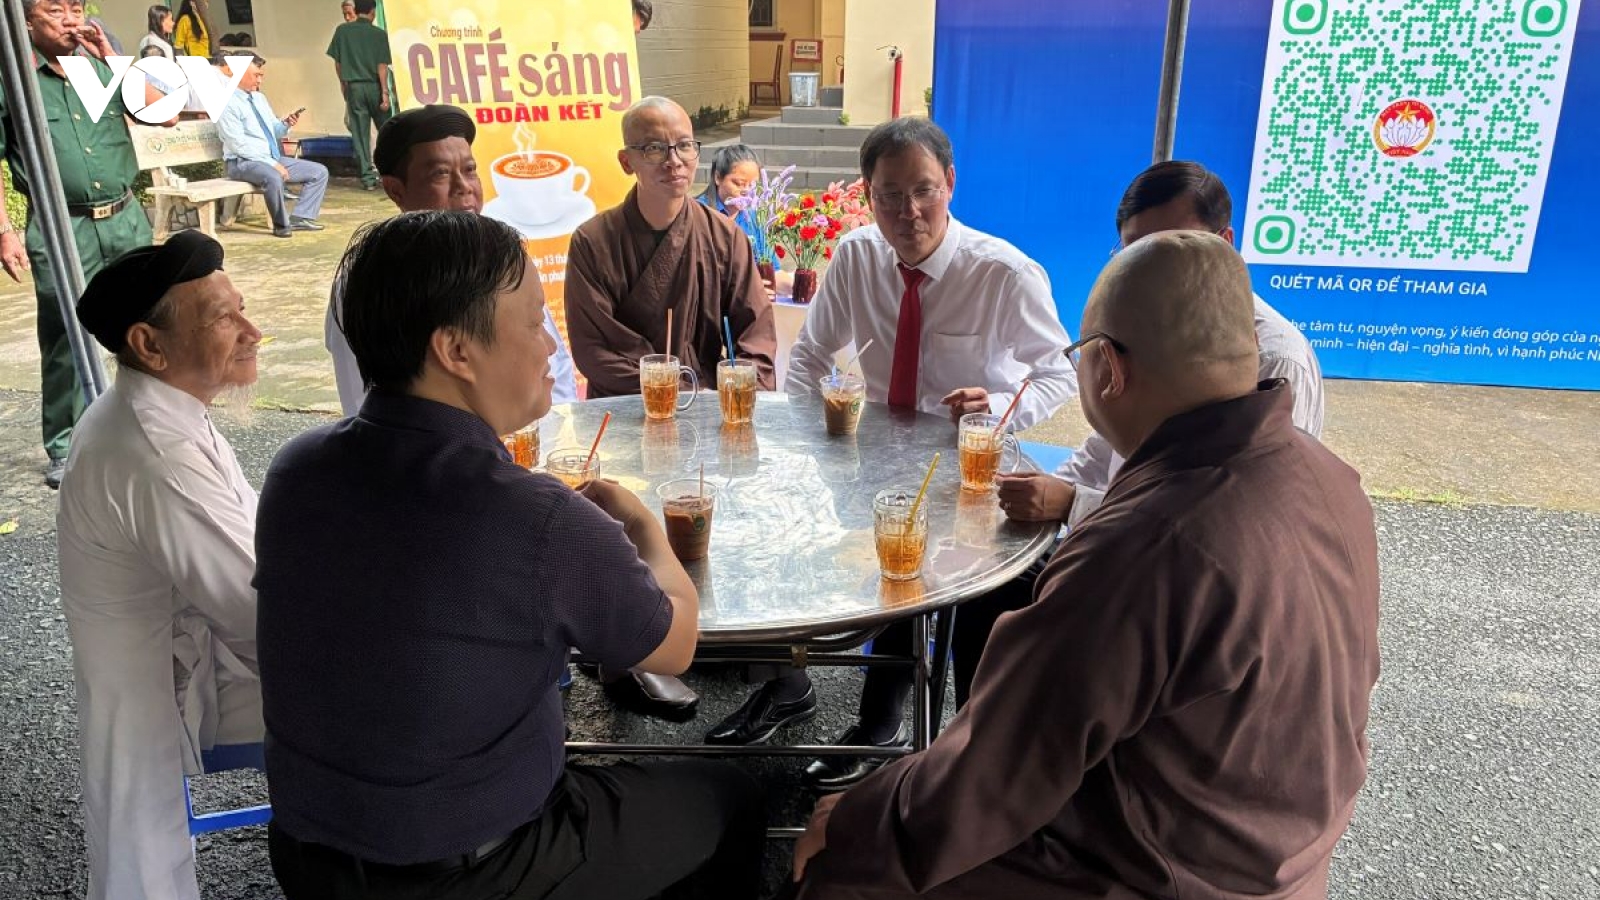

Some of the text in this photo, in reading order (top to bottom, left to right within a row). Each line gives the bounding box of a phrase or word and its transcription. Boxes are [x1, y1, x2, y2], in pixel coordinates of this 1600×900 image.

[408, 27, 632, 111] CAFÉ sáng
[475, 100, 604, 124] ĐOÀN KẾT
[1270, 273, 1488, 296] QUÉT MÃ QR ĐỂ THAM GIA
[1310, 320, 1335, 332] tâm
[1338, 322, 1354, 334] tư,
[1358, 323, 1407, 338] nguyện
[1411, 326, 1447, 339] vọng,
[1450, 325, 1458, 340] ý
[1461, 325, 1489, 339] kiến
[1492, 327, 1529, 343] đóng
[1531, 330, 1560, 344] góp
[1562, 331, 1586, 343] của
[1589, 334, 1600, 346] n
[1310, 338, 1343, 350] minh
[1357, 339, 1385, 353] hiện
[1388, 341, 1409, 354] đại
[1423, 342, 1461, 357] nghĩa
[1463, 343, 1494, 357] tình,
[1497, 345, 1509, 356] vì
[1512, 345, 1546, 360] hạnh
[1549, 347, 1585, 362] phúc
